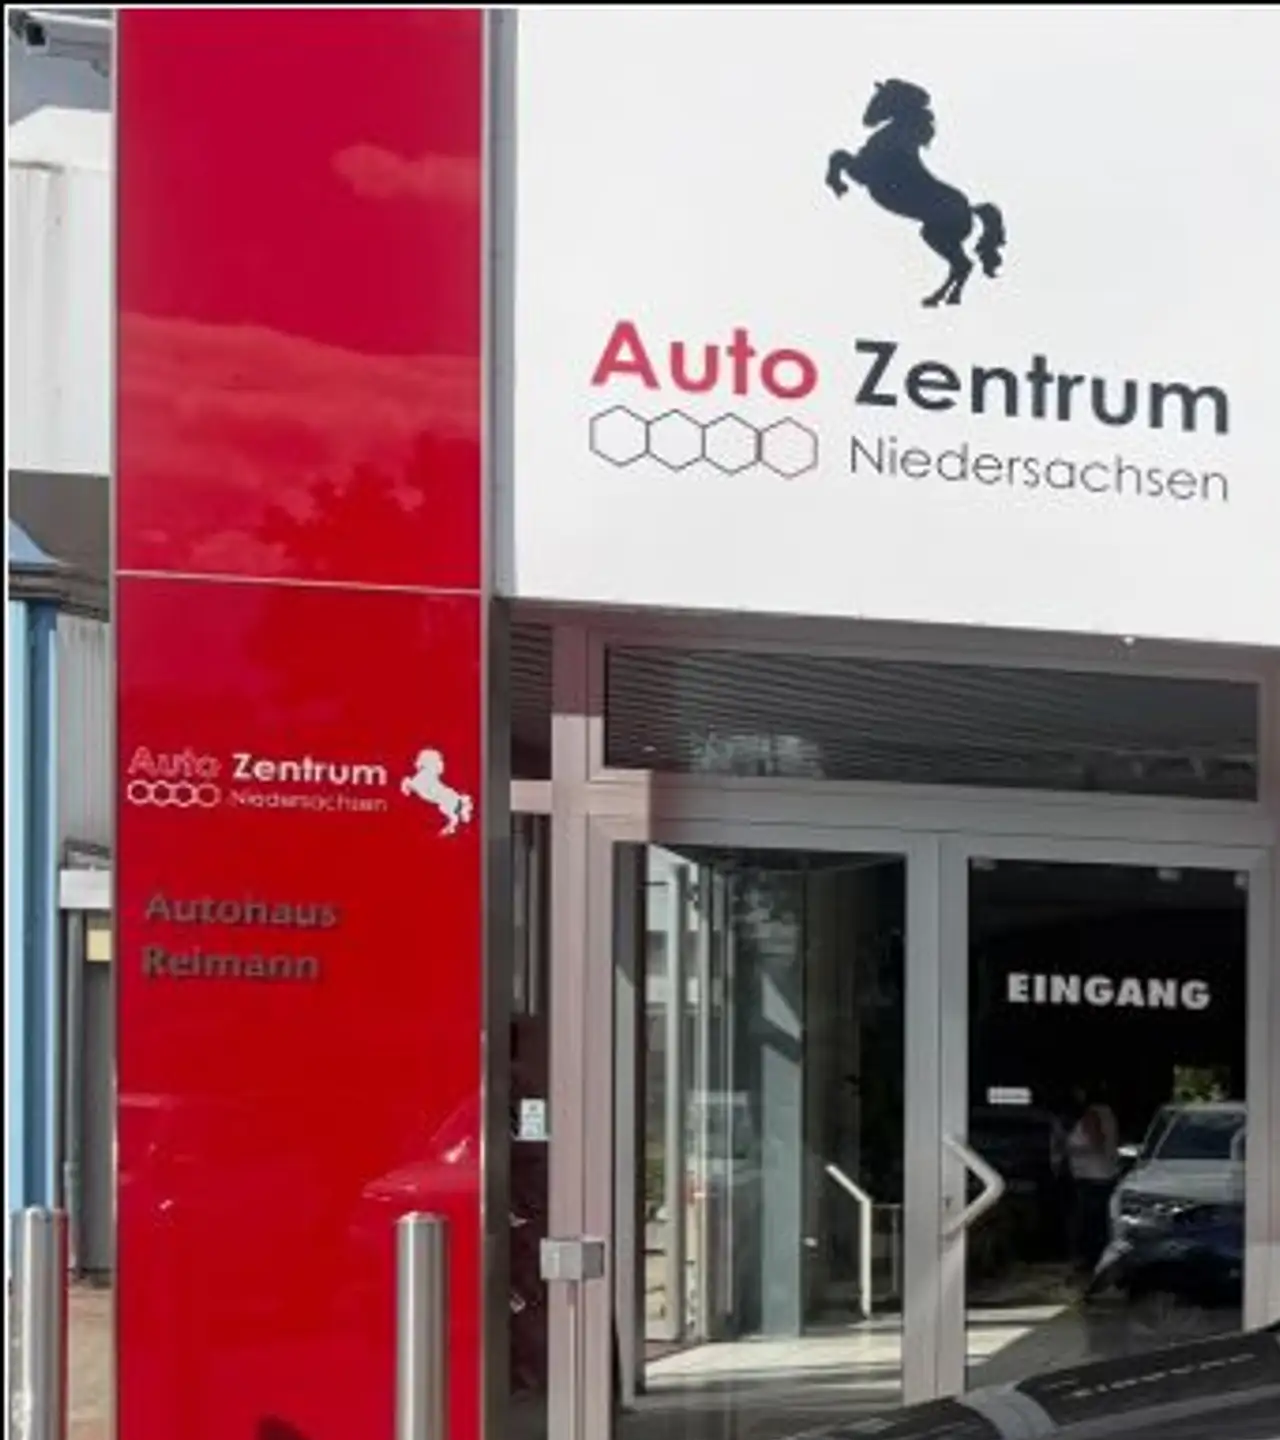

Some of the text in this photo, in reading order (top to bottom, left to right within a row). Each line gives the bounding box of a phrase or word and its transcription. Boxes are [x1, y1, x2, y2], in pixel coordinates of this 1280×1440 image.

[591, 320, 1229, 434] Auto Zentrum
[849, 436, 1229, 502] Niedersachsen
[128, 746, 388, 786] Auto Zentrum
[144, 893, 339, 928] Autohaus
[141, 947, 320, 979] Reimann
[1007, 971, 1211, 1011] EINGANG
